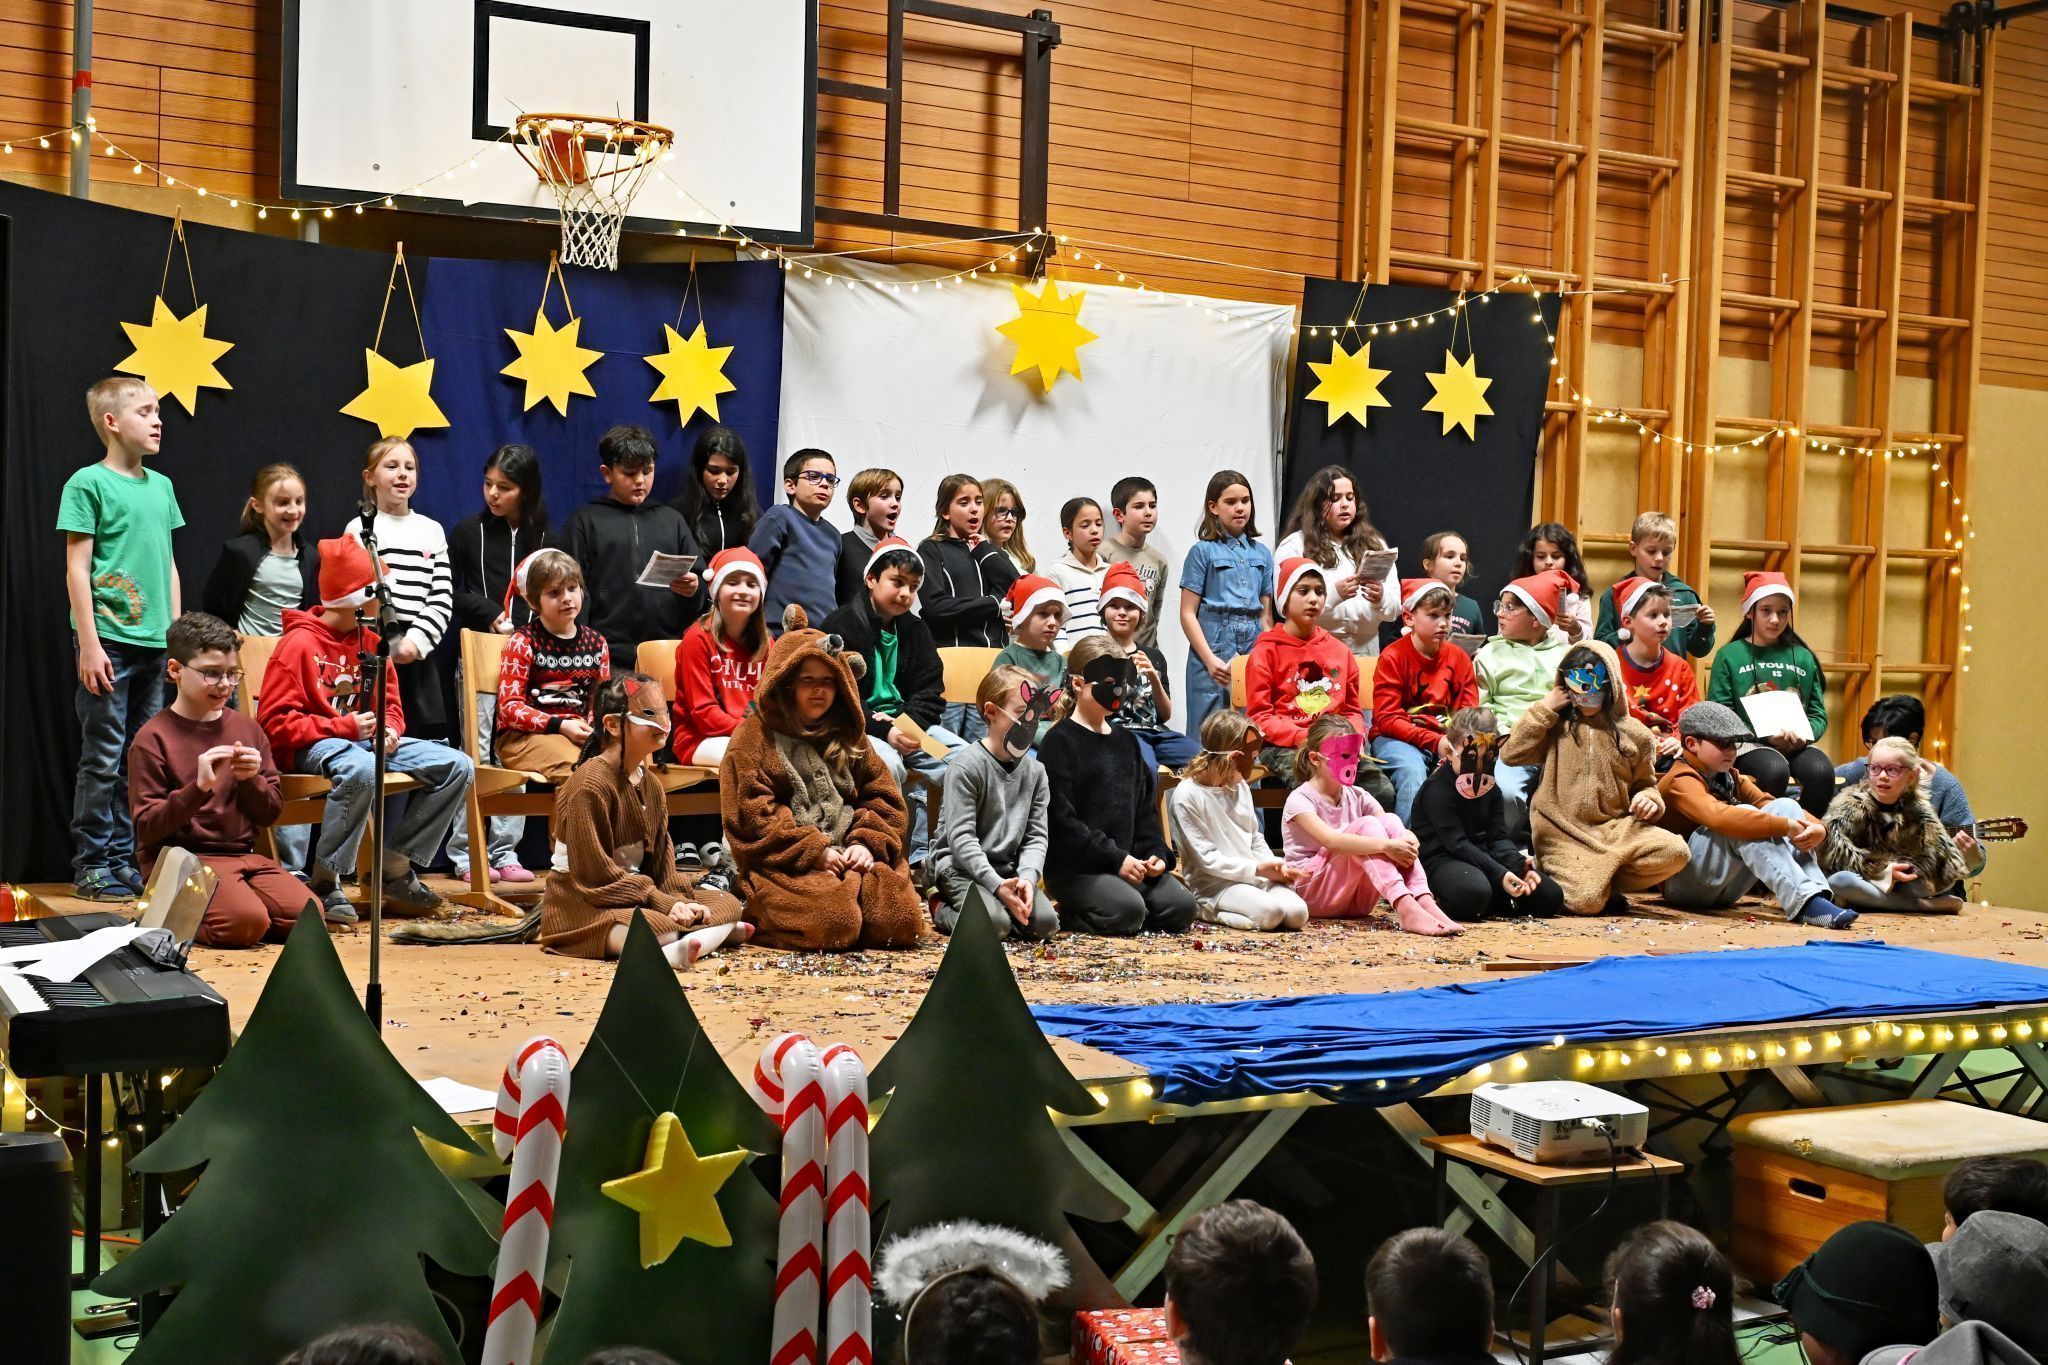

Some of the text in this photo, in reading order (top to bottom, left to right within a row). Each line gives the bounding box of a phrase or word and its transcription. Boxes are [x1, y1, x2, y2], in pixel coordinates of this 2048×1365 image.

[1739, 663, 1757, 674] ALL
[1785, 663, 1807, 677] NEED
[1772, 670, 1783, 678] IS
